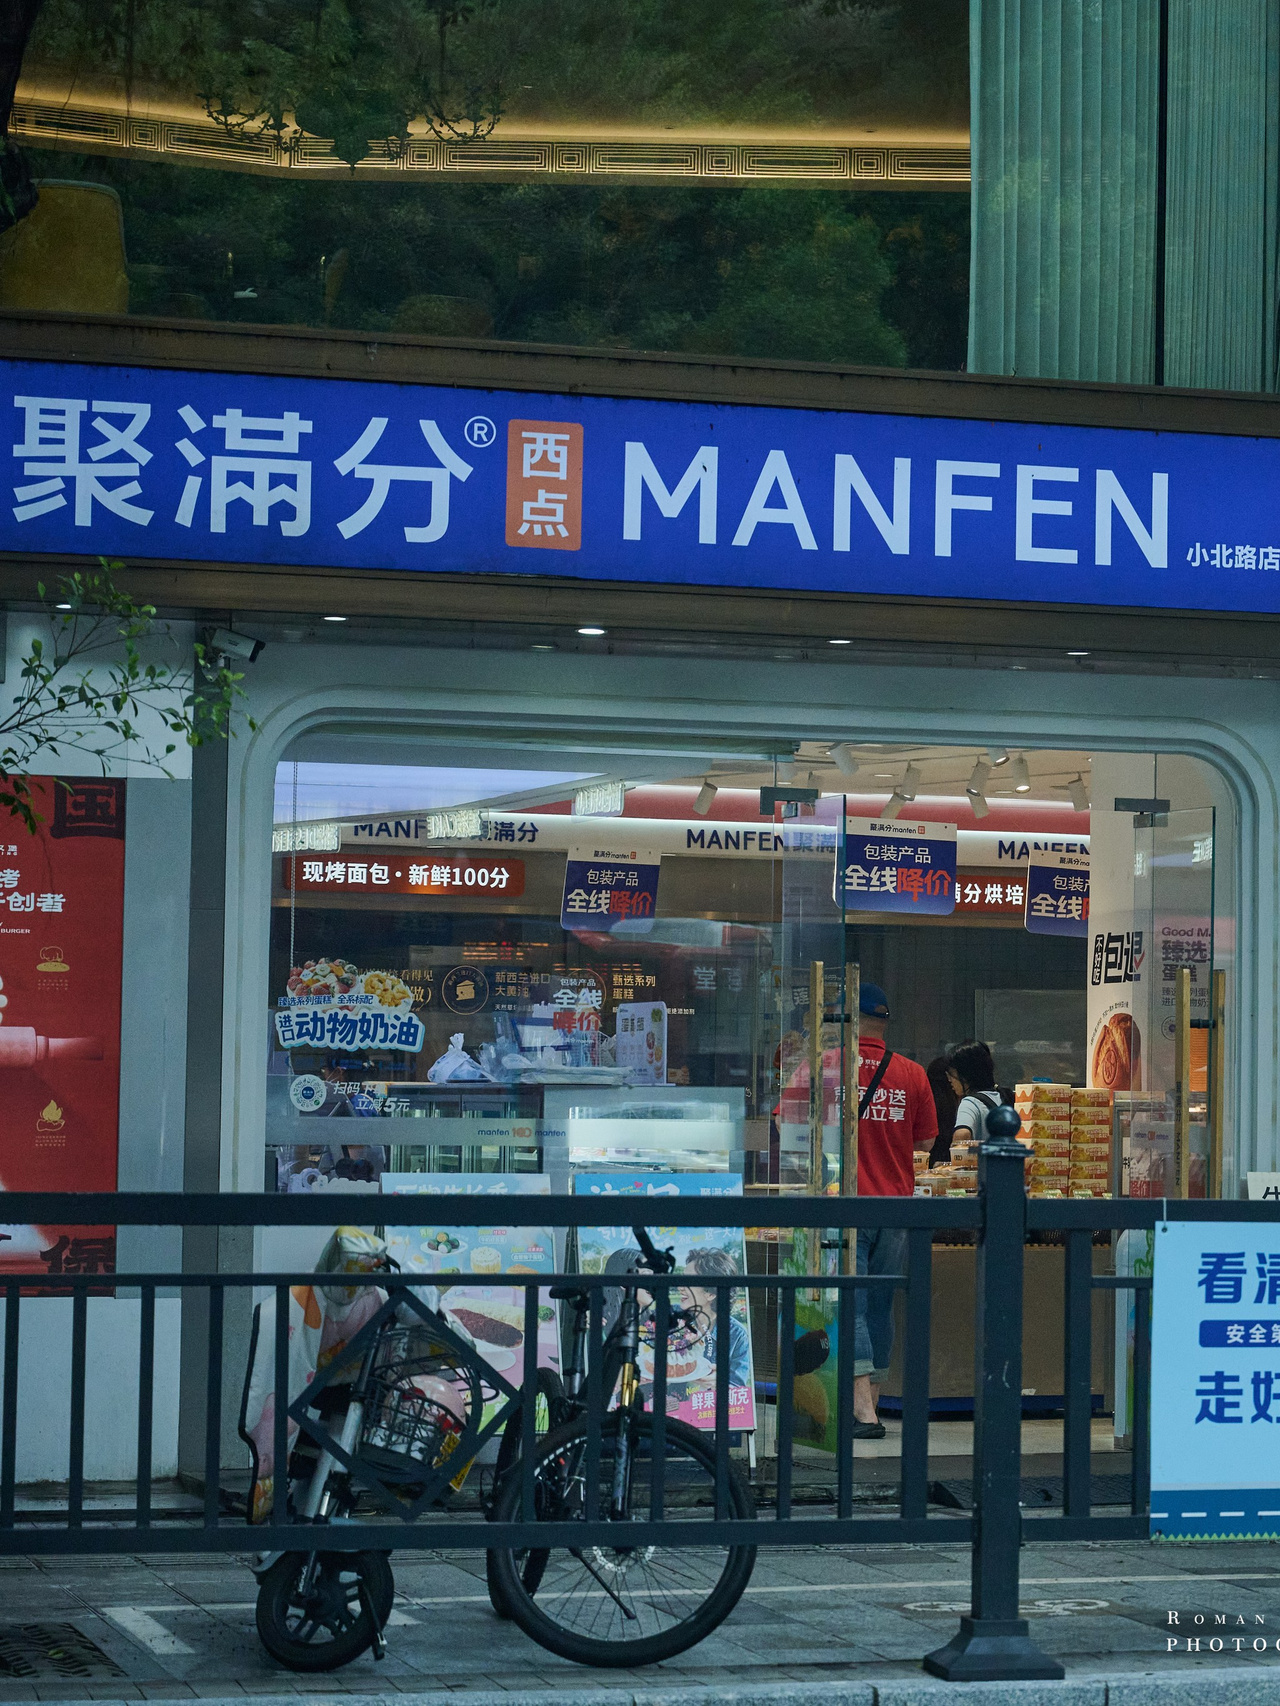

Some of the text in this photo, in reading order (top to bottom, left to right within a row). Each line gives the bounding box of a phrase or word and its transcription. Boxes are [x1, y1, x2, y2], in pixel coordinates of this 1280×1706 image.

[517, 431, 570, 538] 西点
[623, 441, 1169, 568] MANFEN
[1186, 542, 1280, 572] 小北路店
[863, 843, 932, 864] 包装产品
[586, 869, 639, 887] 包装产品
[842, 864, 952, 903] 全线降价
[566, 888, 653, 922] 全线降价
[1161, 926, 1195, 937] Good
[560, 978, 597, 987] 包装产品
[337, 994, 374, 1005] 全系标配
[553, 988, 603, 1011] 全线
[296, 1011, 420, 1047] 动物奶油
[553, 1011, 601, 1034] 降价
